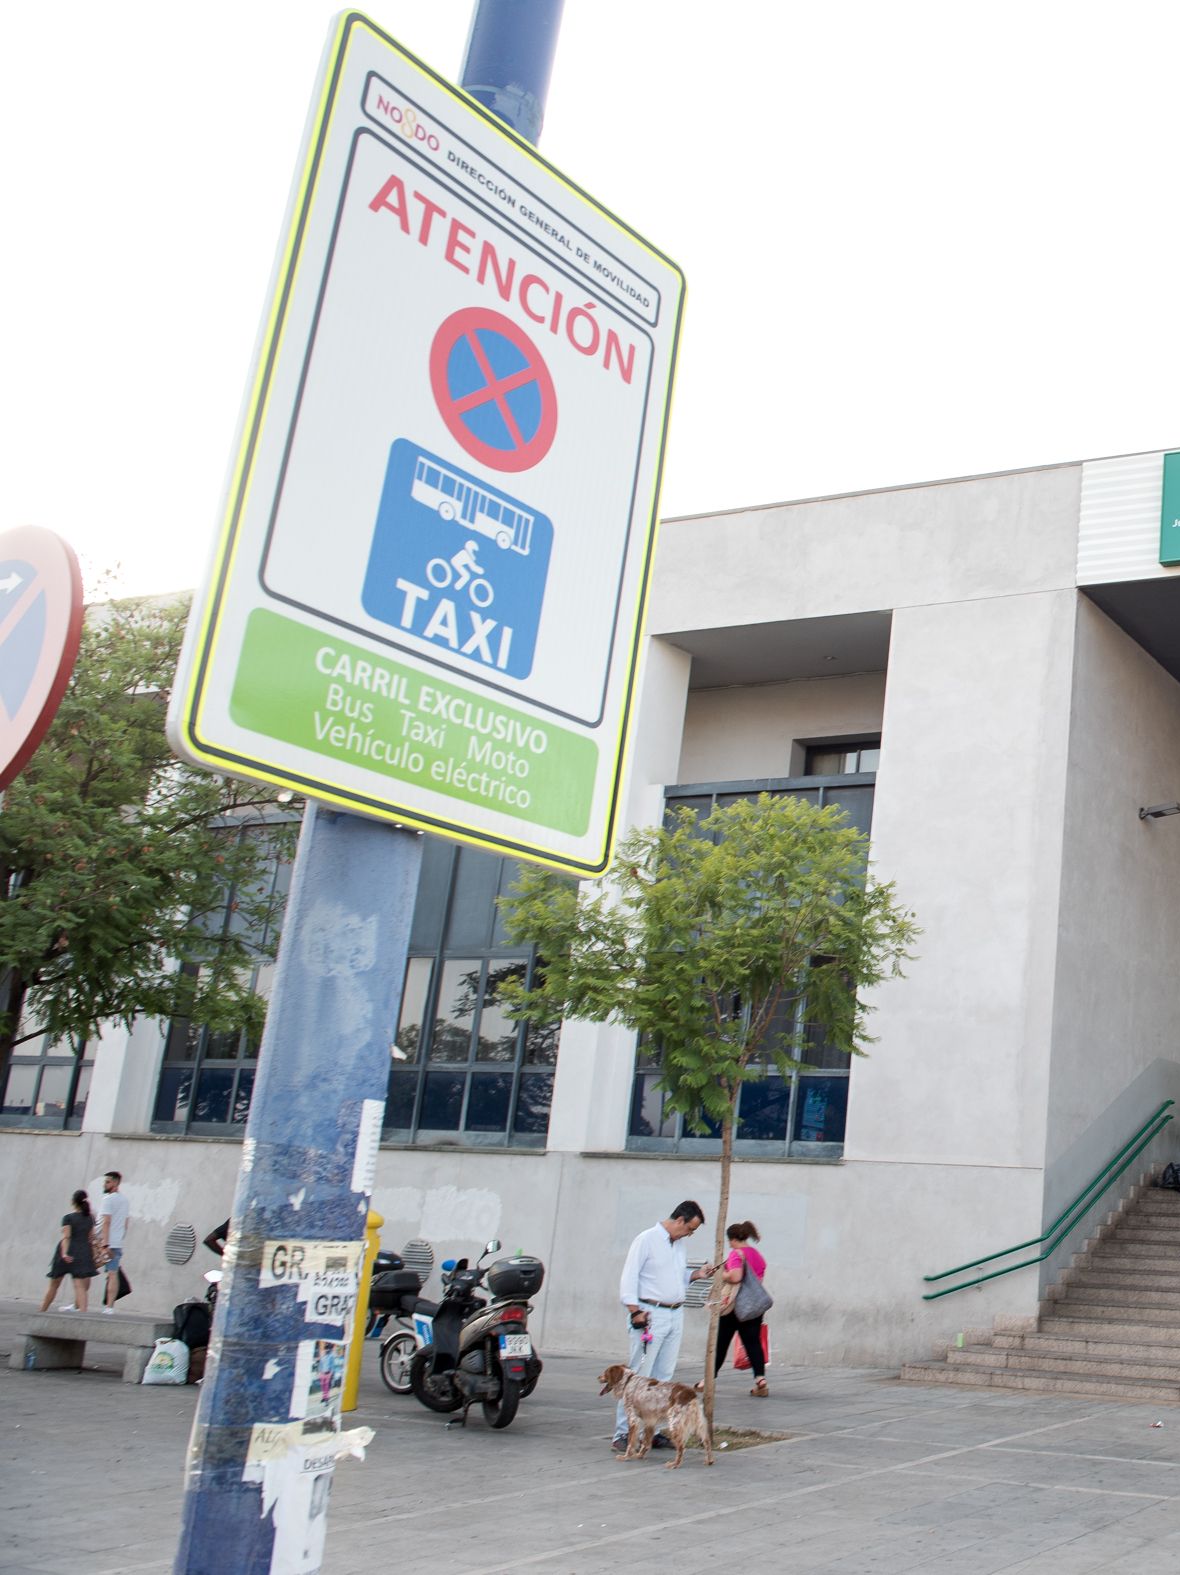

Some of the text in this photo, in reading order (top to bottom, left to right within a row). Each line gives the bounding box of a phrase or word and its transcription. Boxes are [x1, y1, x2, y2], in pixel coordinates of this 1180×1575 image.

[368, 174, 635, 384] ATENCIÓN
[447, 150, 651, 308] DIRECCIÓN GENERAL DE MOVILIDAD
[396, 578, 513, 669] TAXI
[315, 646, 548, 755] CARRIL EXCLUSIVO
[326, 684, 530, 778] Bus Taxi Moto
[313, 711, 531, 809] Vehículo eléctrico
